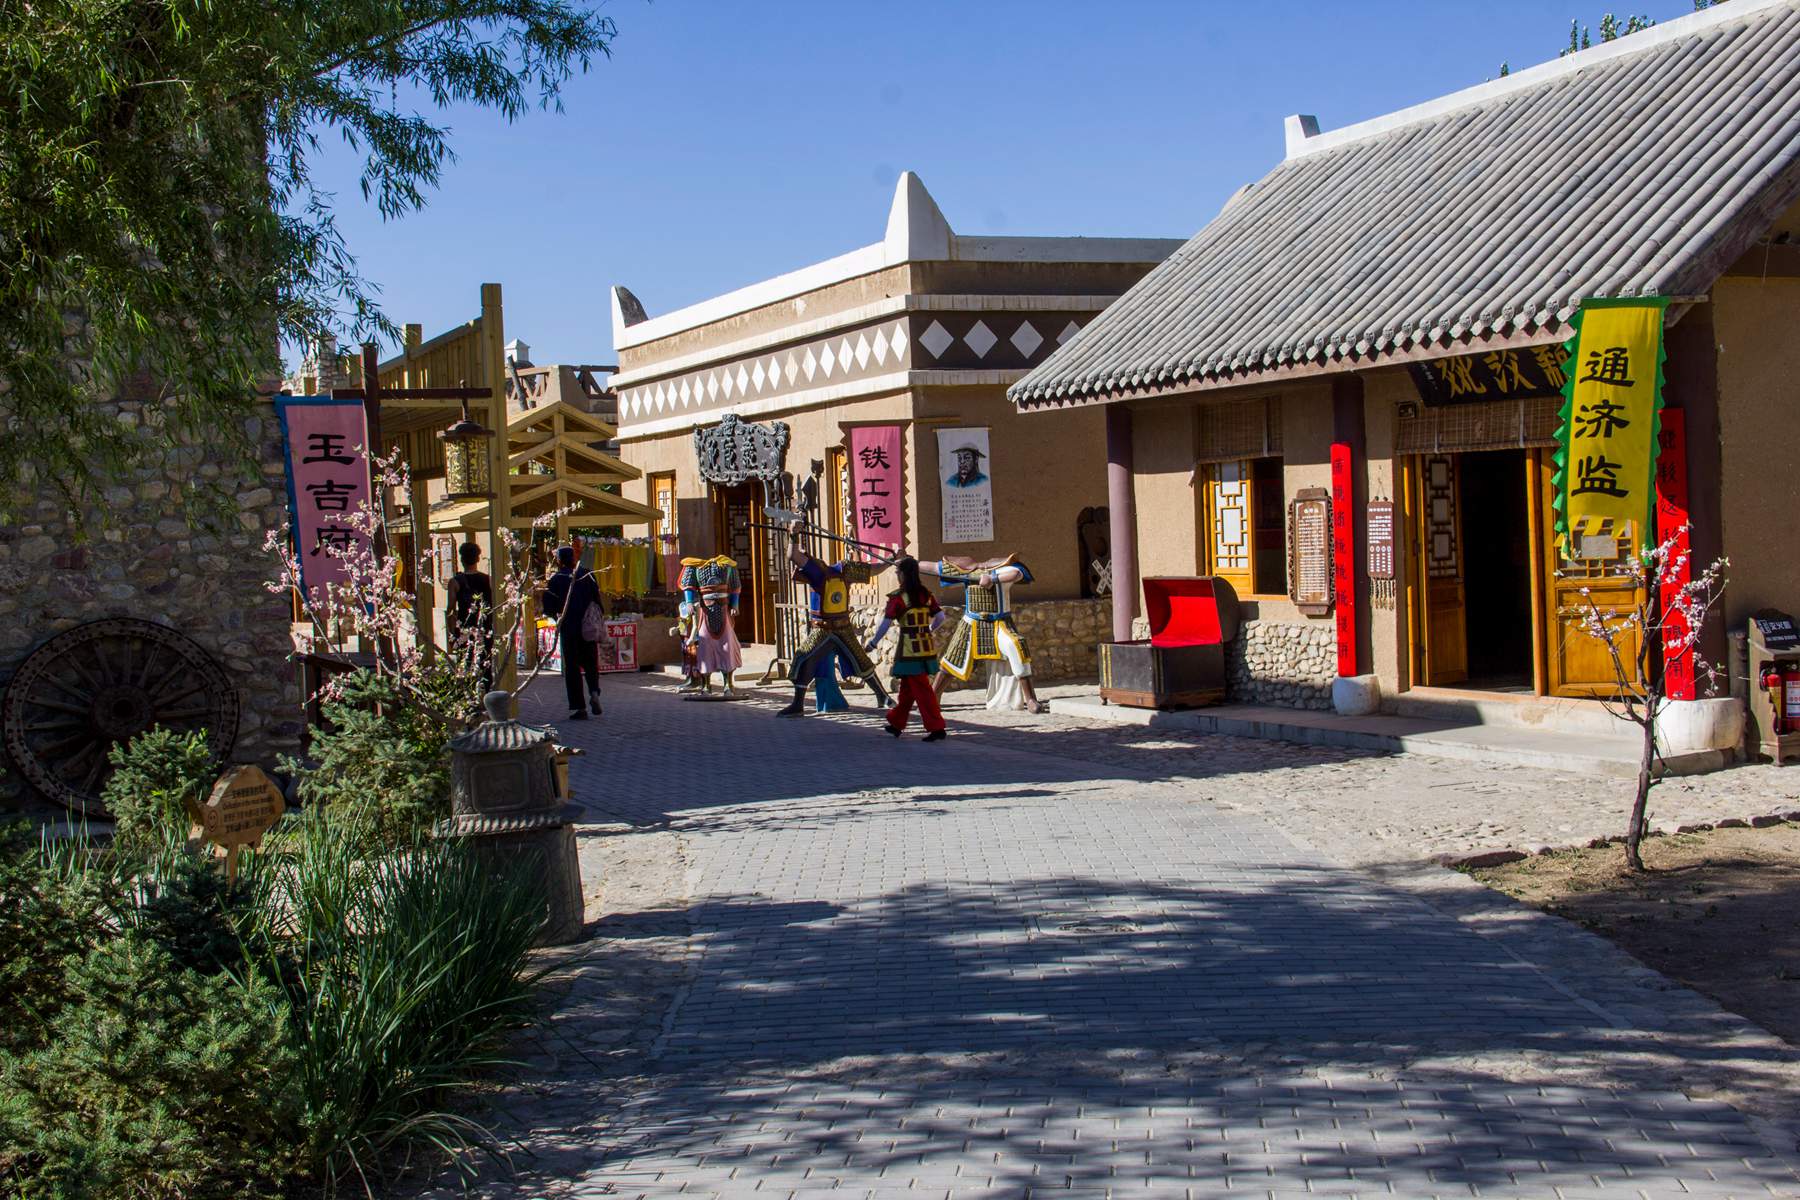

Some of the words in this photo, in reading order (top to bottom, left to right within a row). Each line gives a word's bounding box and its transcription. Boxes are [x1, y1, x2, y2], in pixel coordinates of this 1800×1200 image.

[1570, 346, 1636, 498] 通济监
[302, 433, 360, 560] 玉吉府
[858, 445, 892, 529] 铁工院
